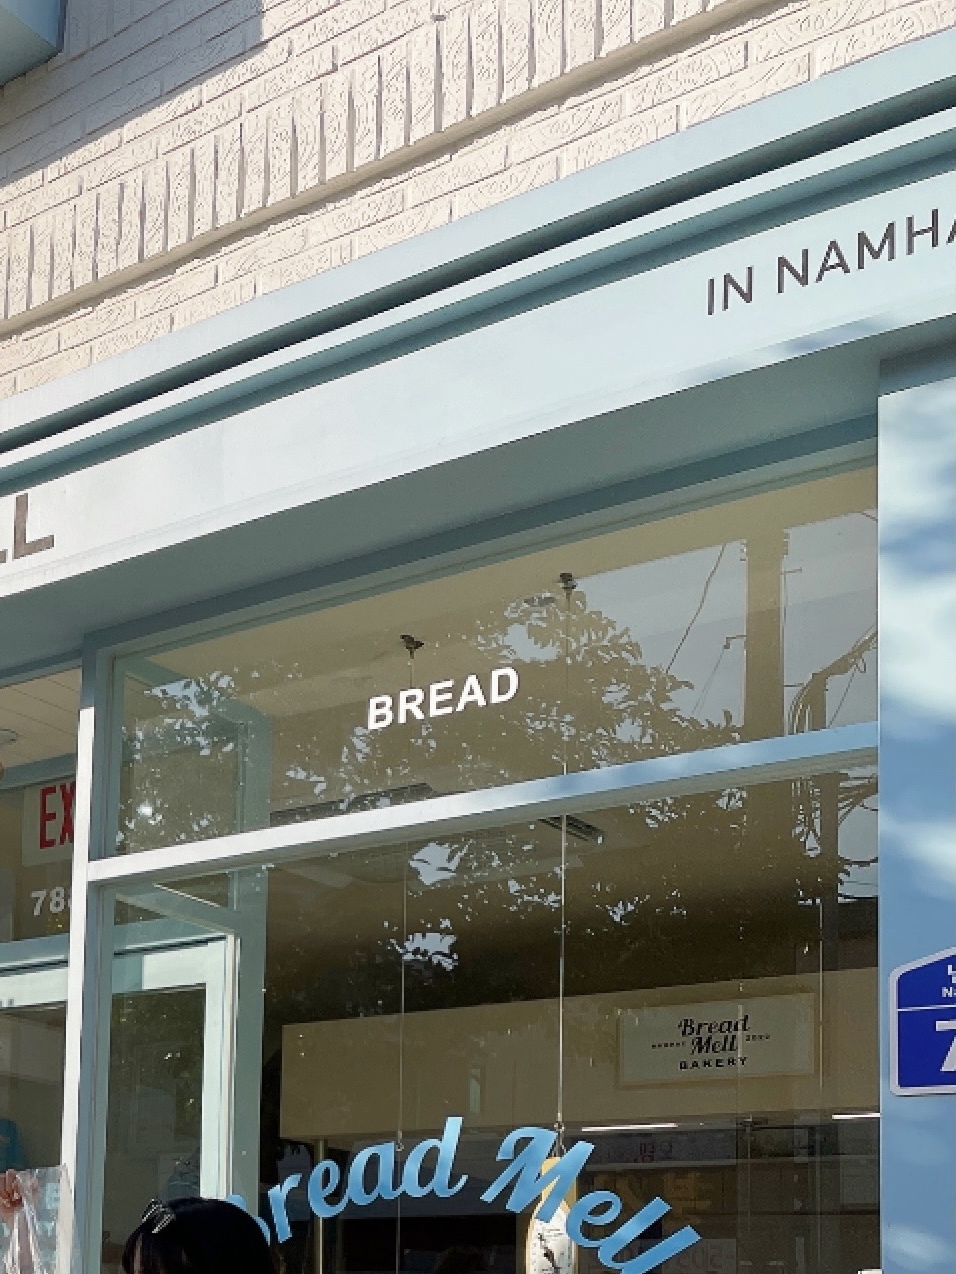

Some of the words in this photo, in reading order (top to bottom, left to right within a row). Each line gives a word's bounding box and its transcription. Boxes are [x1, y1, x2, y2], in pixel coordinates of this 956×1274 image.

[707, 265, 755, 315] IN
[367, 667, 520, 731] BREAD
[30, 886, 72, 917] 78
[677, 1014, 751, 1038] Bread
[690, 1034, 740, 1055] Mell
[679, 1056, 749, 1070] BAKERY
[227, 1116, 469, 1245] read
